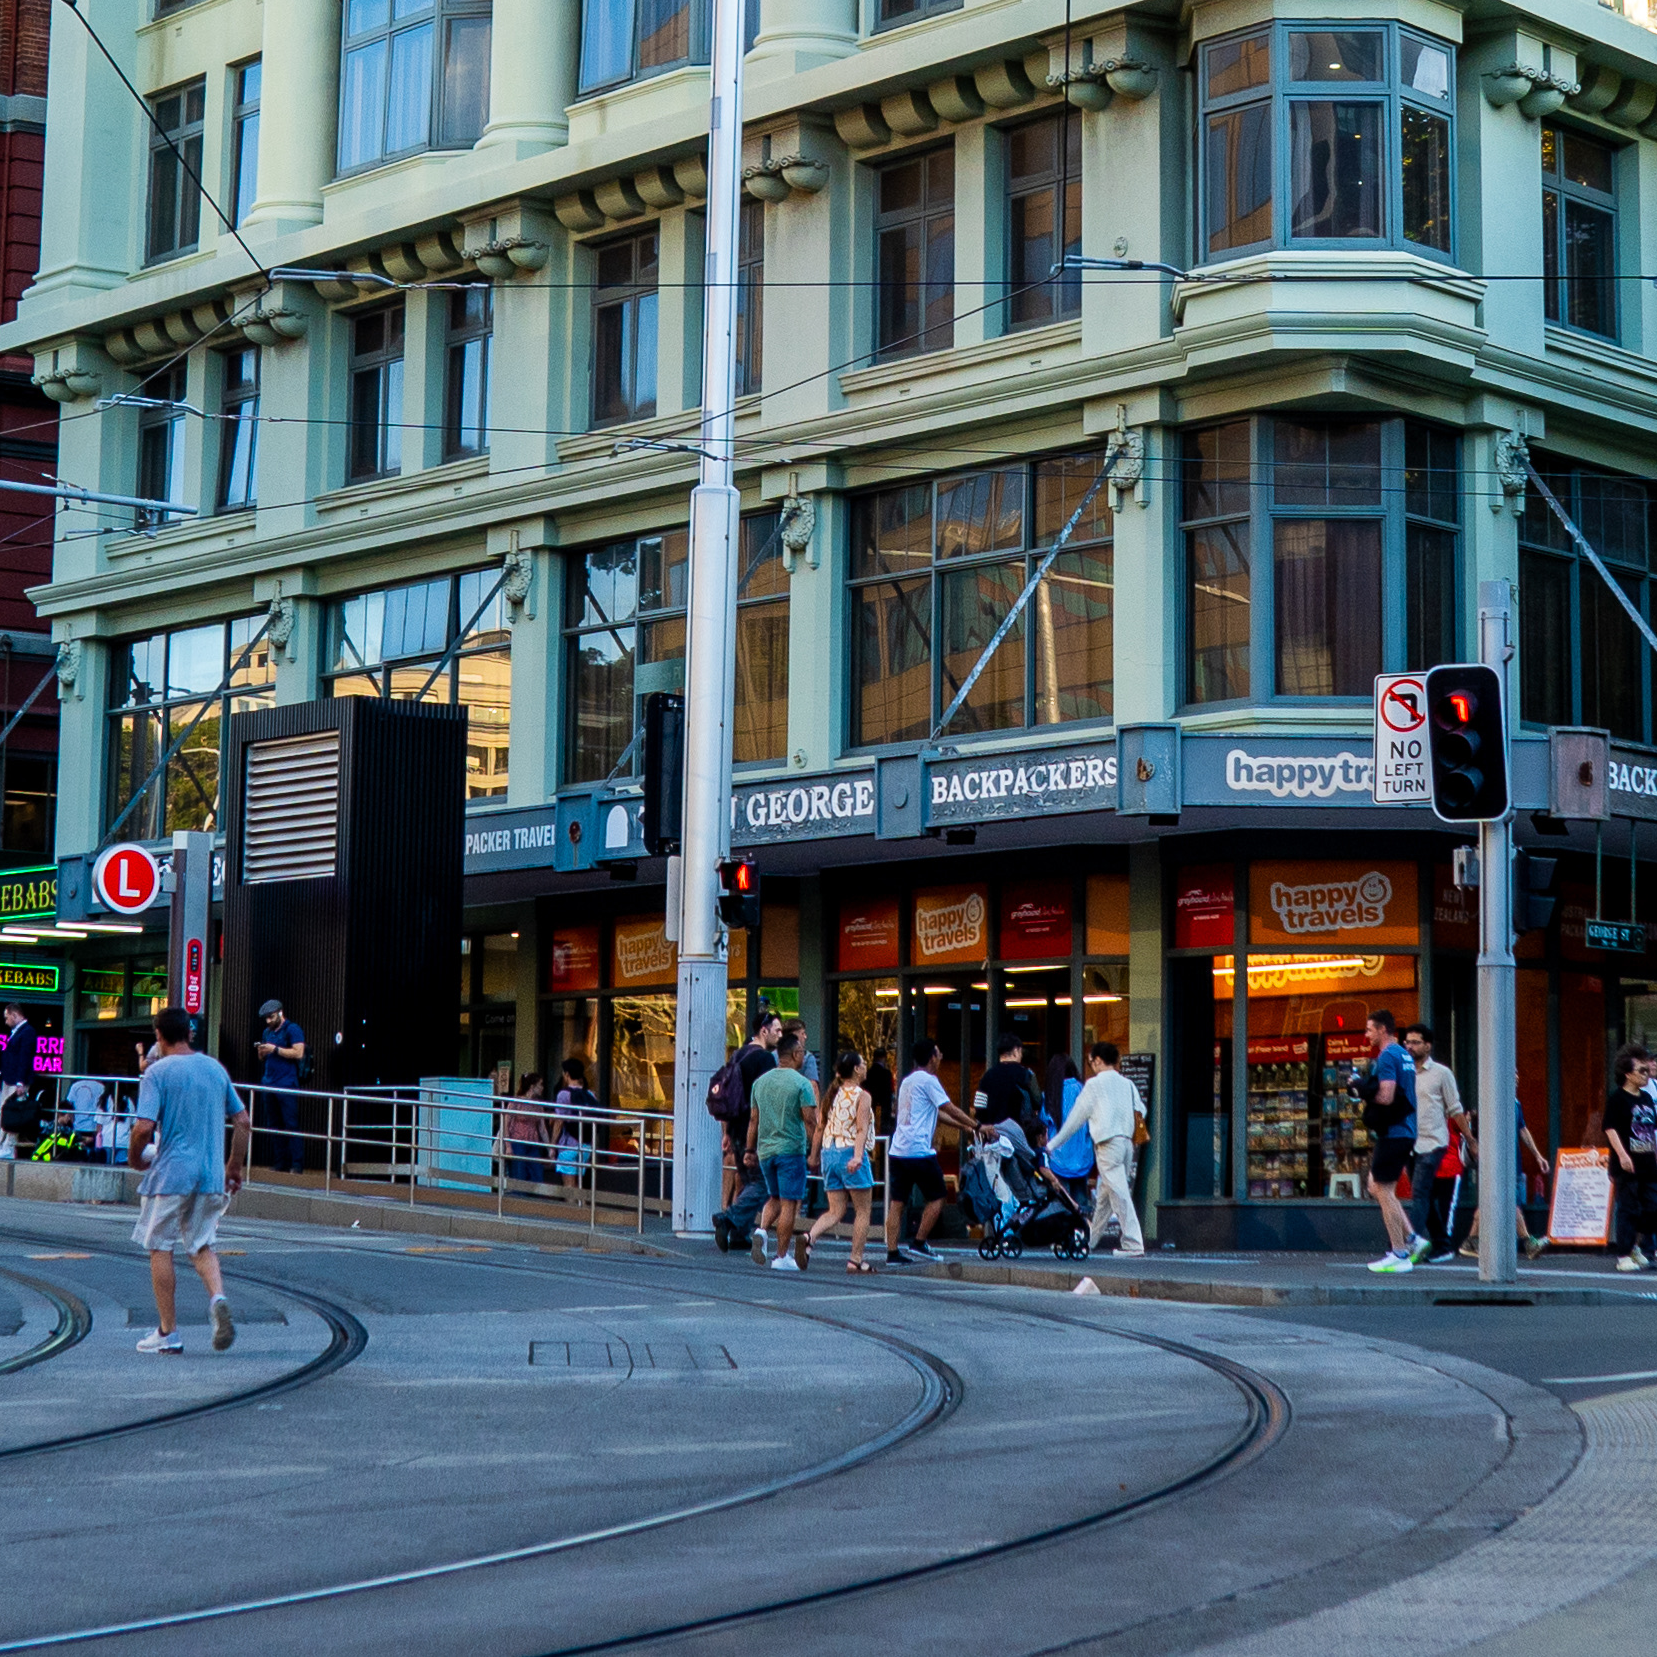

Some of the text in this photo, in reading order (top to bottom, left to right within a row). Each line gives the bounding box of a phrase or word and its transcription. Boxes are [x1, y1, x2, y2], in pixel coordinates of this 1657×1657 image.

[1391, 740, 1422, 759] NO
[931, 757, 1118, 804] BACKPACKERS
[1233, 756, 1336, 790] happy
[1384, 762, 1424, 777] LEFT
[1382, 779, 1426, 793] TURN
[746, 780, 875, 827] GEORGE
[119, 858, 140, 897] L
[1275, 886, 1357, 910] happy
[918, 909, 965, 931] happy
[1285, 903, 1380, 928] travels
[619, 934, 660, 956] happy
[923, 925, 976, 950] travels
[1588, 925, 1618, 941] GEORGE
[624, 949, 670, 974] travels
[33, 1056, 63, 1072] BAR
